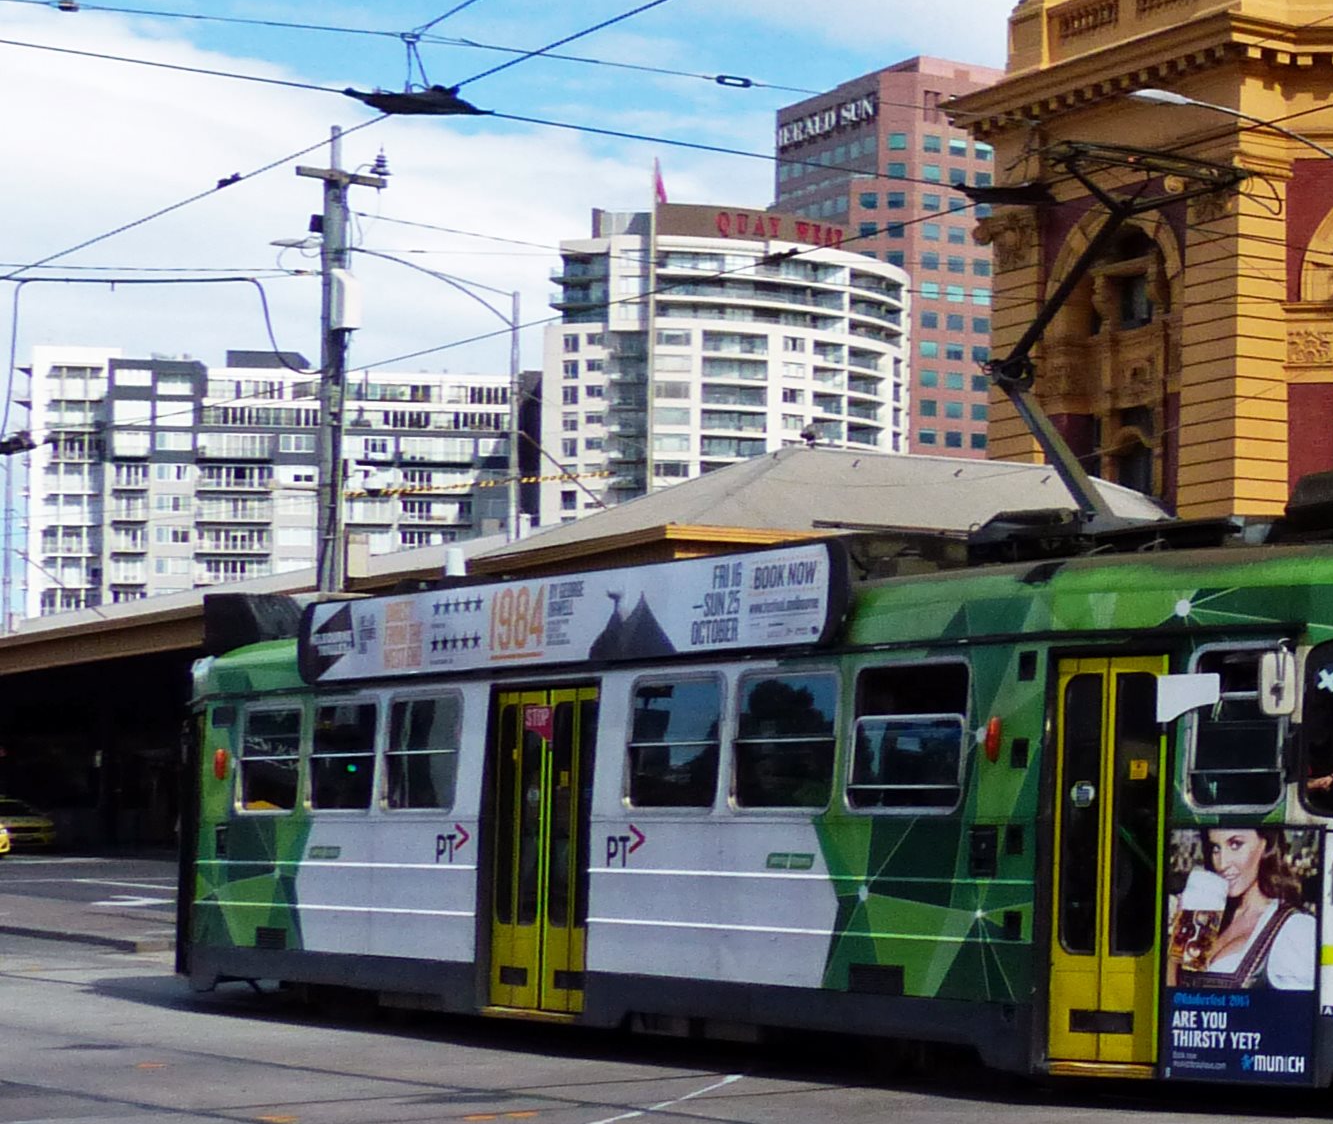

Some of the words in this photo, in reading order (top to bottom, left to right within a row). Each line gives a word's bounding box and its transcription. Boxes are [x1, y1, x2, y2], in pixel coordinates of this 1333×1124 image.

[841, 98, 875, 126] SUN
[715, 211, 781, 238] QUAY
[753, 563, 786, 590] BOOK
[787, 560, 817, 586] NOW
[488, 585, 545, 652] 1984
[690, 617, 739, 646] OCTOBER
[525, 707, 550, 727] STOP
[435, 834, 457, 864] PT
[606, 835, 631, 868] PT
[1172, 1010, 1198, 1029] ARE
[1200, 1011, 1228, 1030] YOU
[1171, 1030, 1227, 1050] THIRSTY
[1230, 1031, 1262, 1050] YET?
